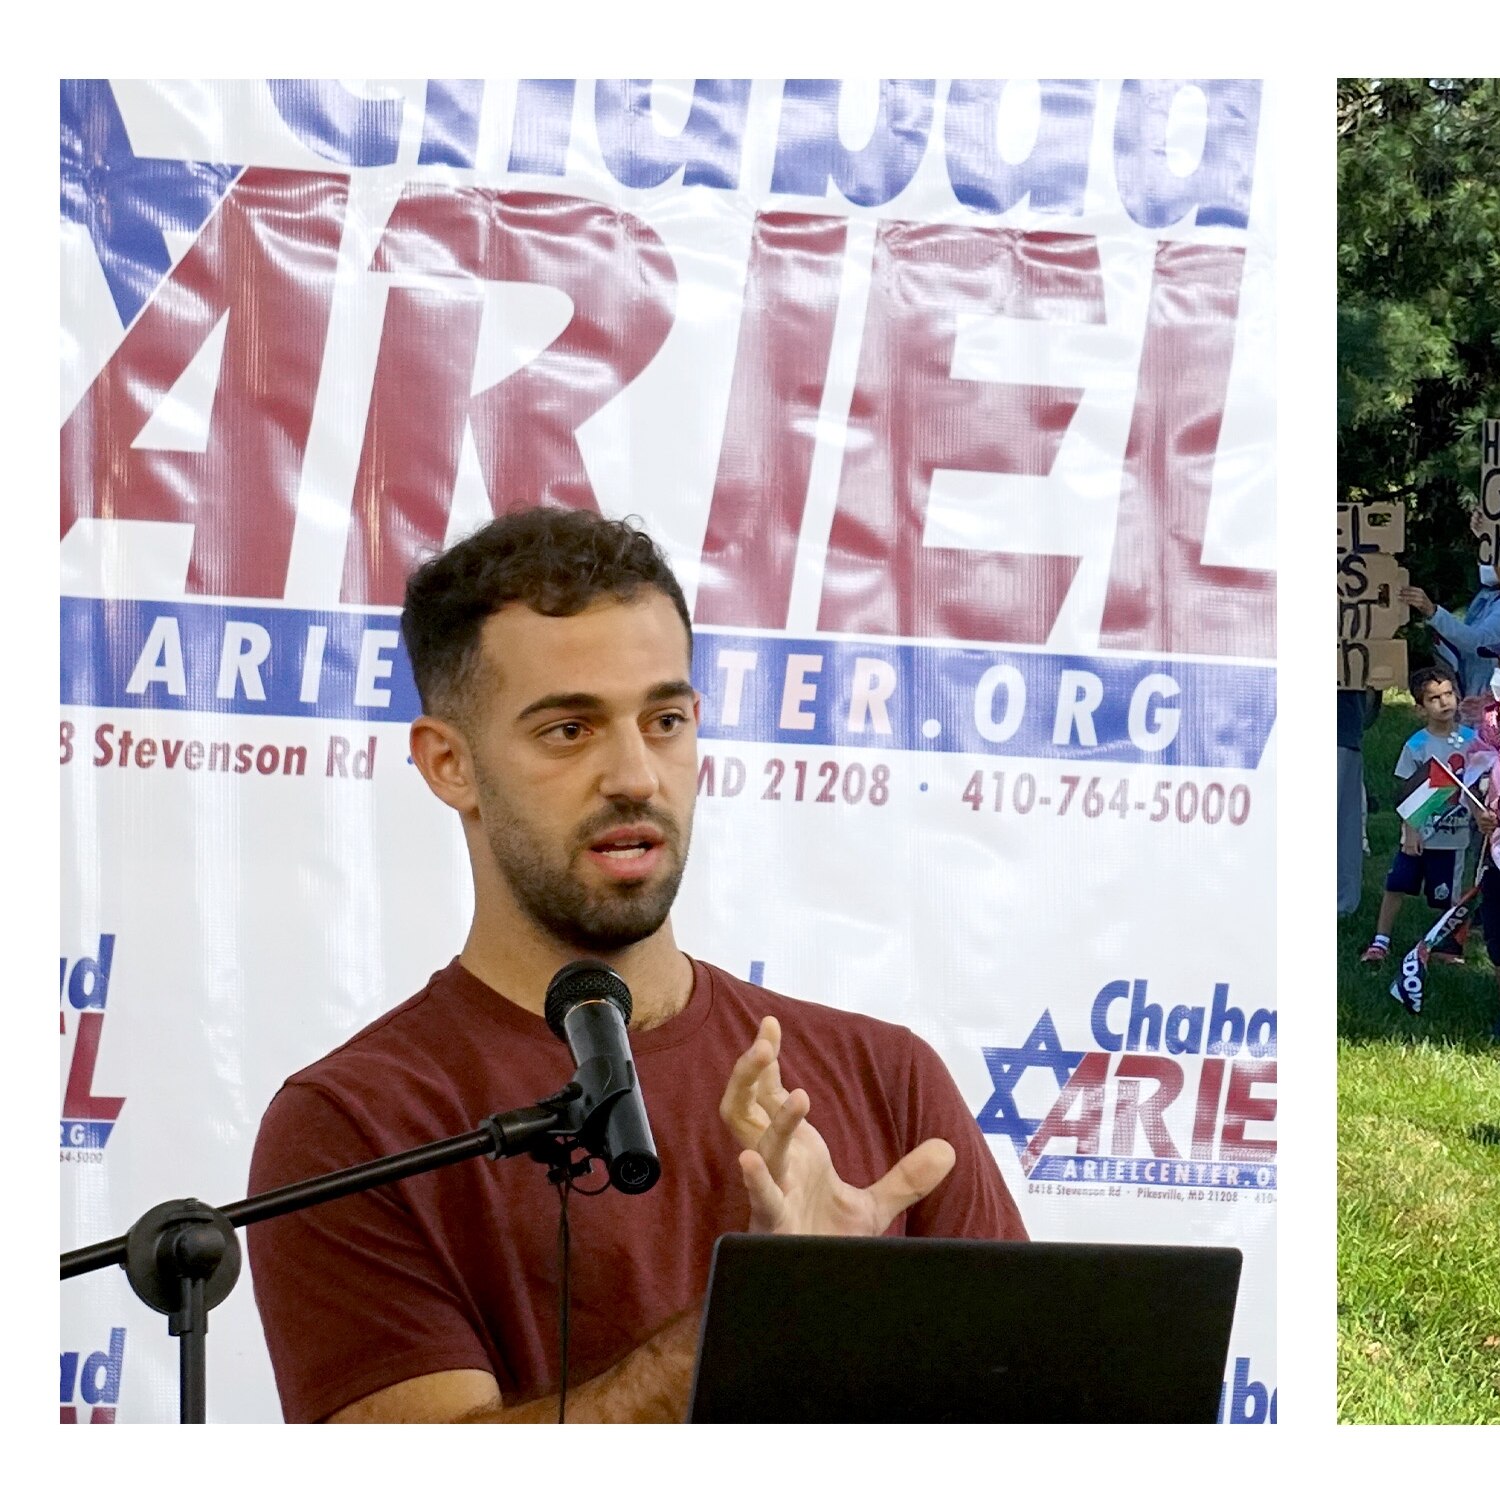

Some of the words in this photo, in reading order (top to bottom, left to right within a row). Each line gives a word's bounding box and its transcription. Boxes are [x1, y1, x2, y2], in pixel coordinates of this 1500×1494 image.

[60, 166, 1276, 661] ARIEL
[126, 616, 1182, 752] ARIETER.ORG
[93, 723, 304, 776] Stevenson
[325, 736, 376, 780] Rd
[763, 758, 891, 807] 21208
[961, 769, 1251, 827] 410-764-5000
[60, 934, 115, 1009] d
[1056, 1185, 1104, 1197] Stevenson
[1108, 1187, 1121, 1197] Rd
[1188, 1190, 1204, 1201] MD
[1208, 1190, 1238, 1203] 21208
